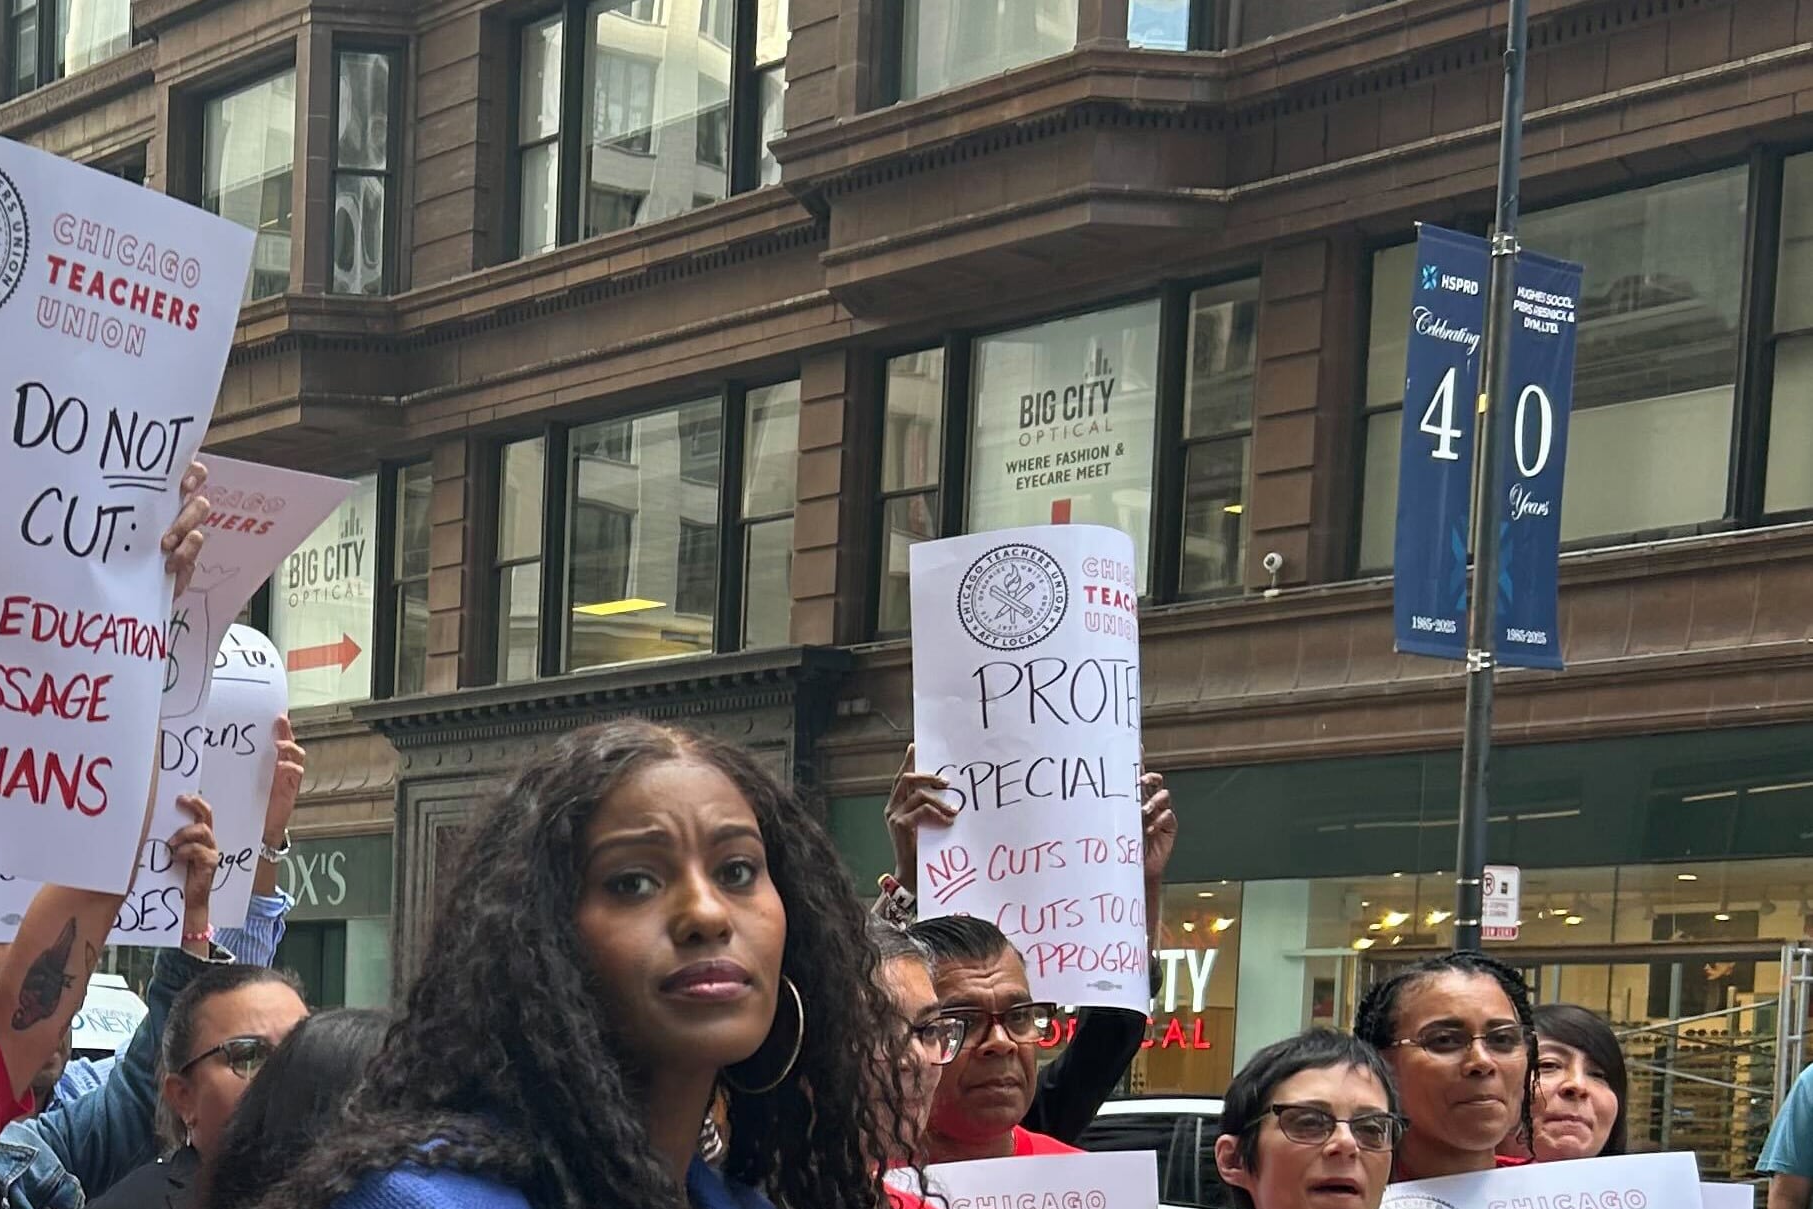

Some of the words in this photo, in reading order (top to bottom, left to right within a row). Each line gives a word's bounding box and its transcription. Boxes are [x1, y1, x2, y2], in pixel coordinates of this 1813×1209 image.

[1, 220, 24, 288] UNION
[52, 211, 202, 289] CHICAGO
[46, 254, 202, 332] TEACHERS
[1441, 273, 1480, 296] HSPRD
[36, 295, 148, 358] UNION
[1412, 305, 1481, 356] Celebrating
[12, 380, 89, 455] DO
[98, 407, 195, 476] NOT
[1019, 389, 1057, 430] BIG
[1062, 377, 1116, 422] CITY
[1419, 366, 1463, 462] 4
[1018, 419, 1114, 448] OPTICAL
[1512, 383, 1554, 479] 0
[1005, 453, 1052, 475] WHERE
[1055, 445, 1110, 469] FASHION
[1115, 442, 1125, 456] &
[1015, 469, 1072, 491] EYECARE
[1076, 462, 1112, 481] MEET
[20, 486, 138, 565] CUT:
[1509, 482, 1550, 521] Years
[288, 547, 320, 590] BIG
[323, 538, 366, 581] CITY
[962, 564, 984, 628] CHICAGO
[986, 548, 1053, 570] TEACHERS
[1051, 571, 1065, 614] UNION
[287, 582, 364, 609] OPTICAL
[977, 630, 998, 646] AFT
[1001, 630, 1041, 647] LOCAL
[935, 755, 1129, 813] SPECIAL
[925, 845, 970, 888] NO
[987, 841, 1068, 882] CUTS
[1075, 837, 1109, 864] TO
[995, 898, 1085, 936] CUTS
[1089, 892, 1125, 924] TO
